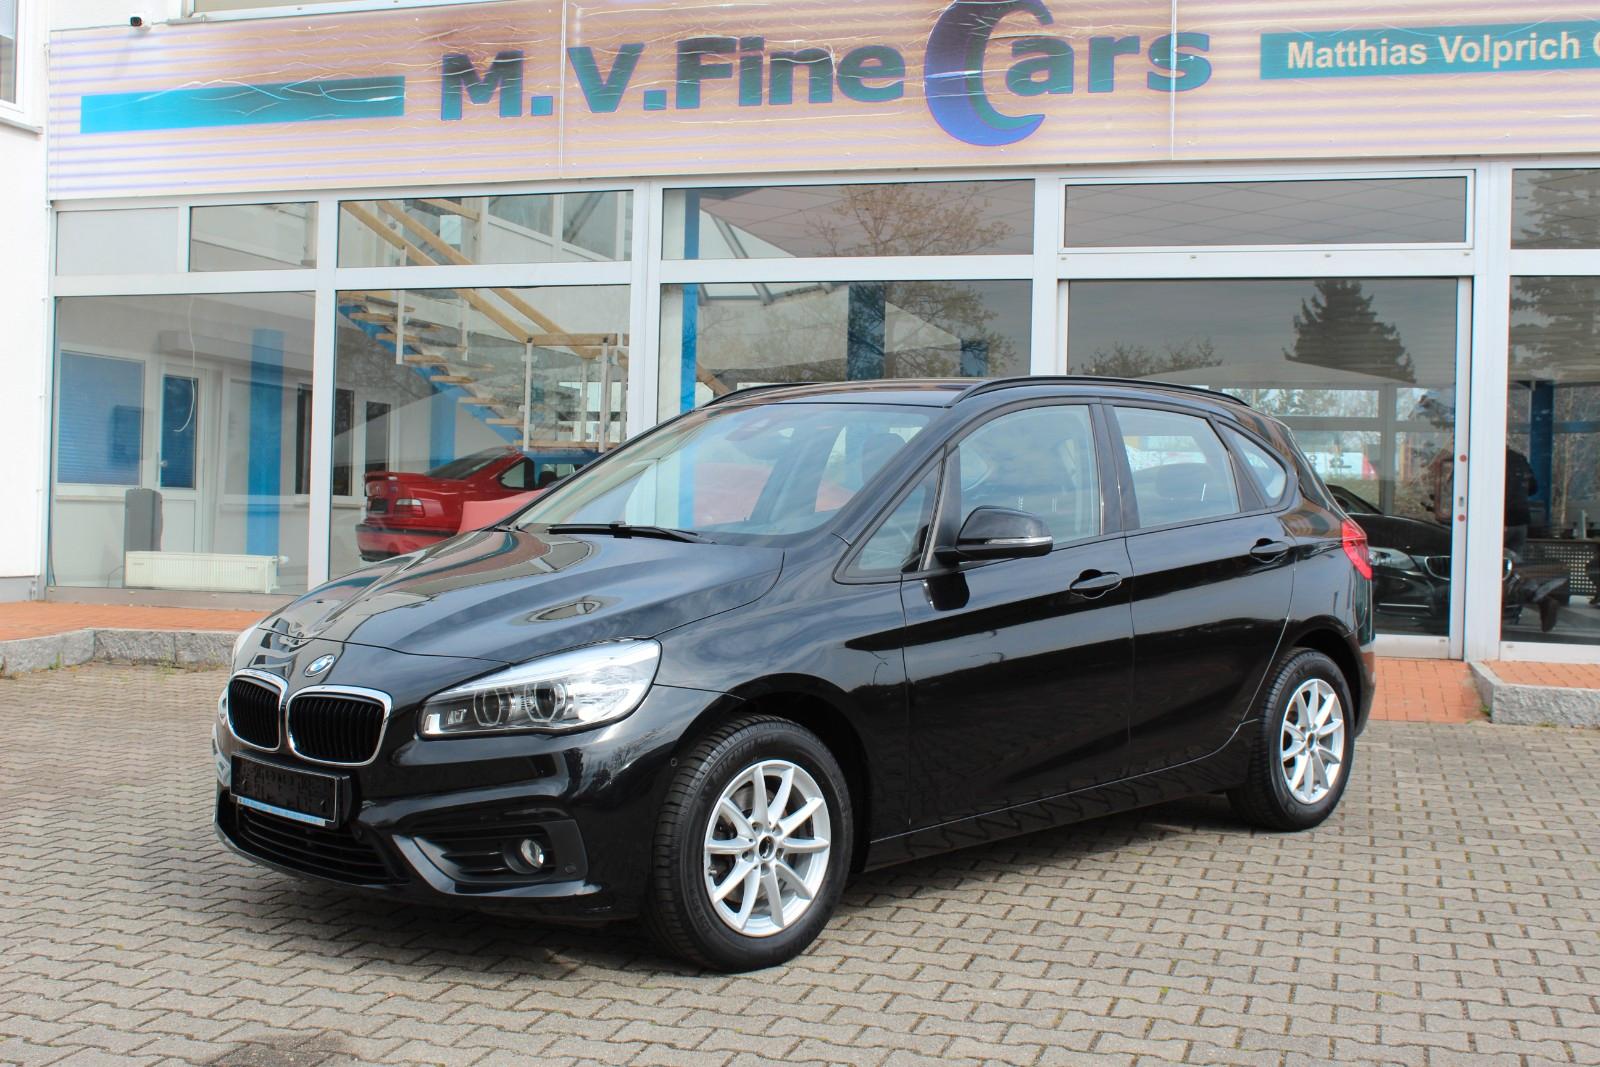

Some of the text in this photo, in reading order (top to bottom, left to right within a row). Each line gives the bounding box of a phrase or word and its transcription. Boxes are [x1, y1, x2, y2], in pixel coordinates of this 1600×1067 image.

[924, 0, 1212, 146] Cars
[1287, 38, 1428, 69] Matthias
[1438, 31, 1581, 69] Volprich
